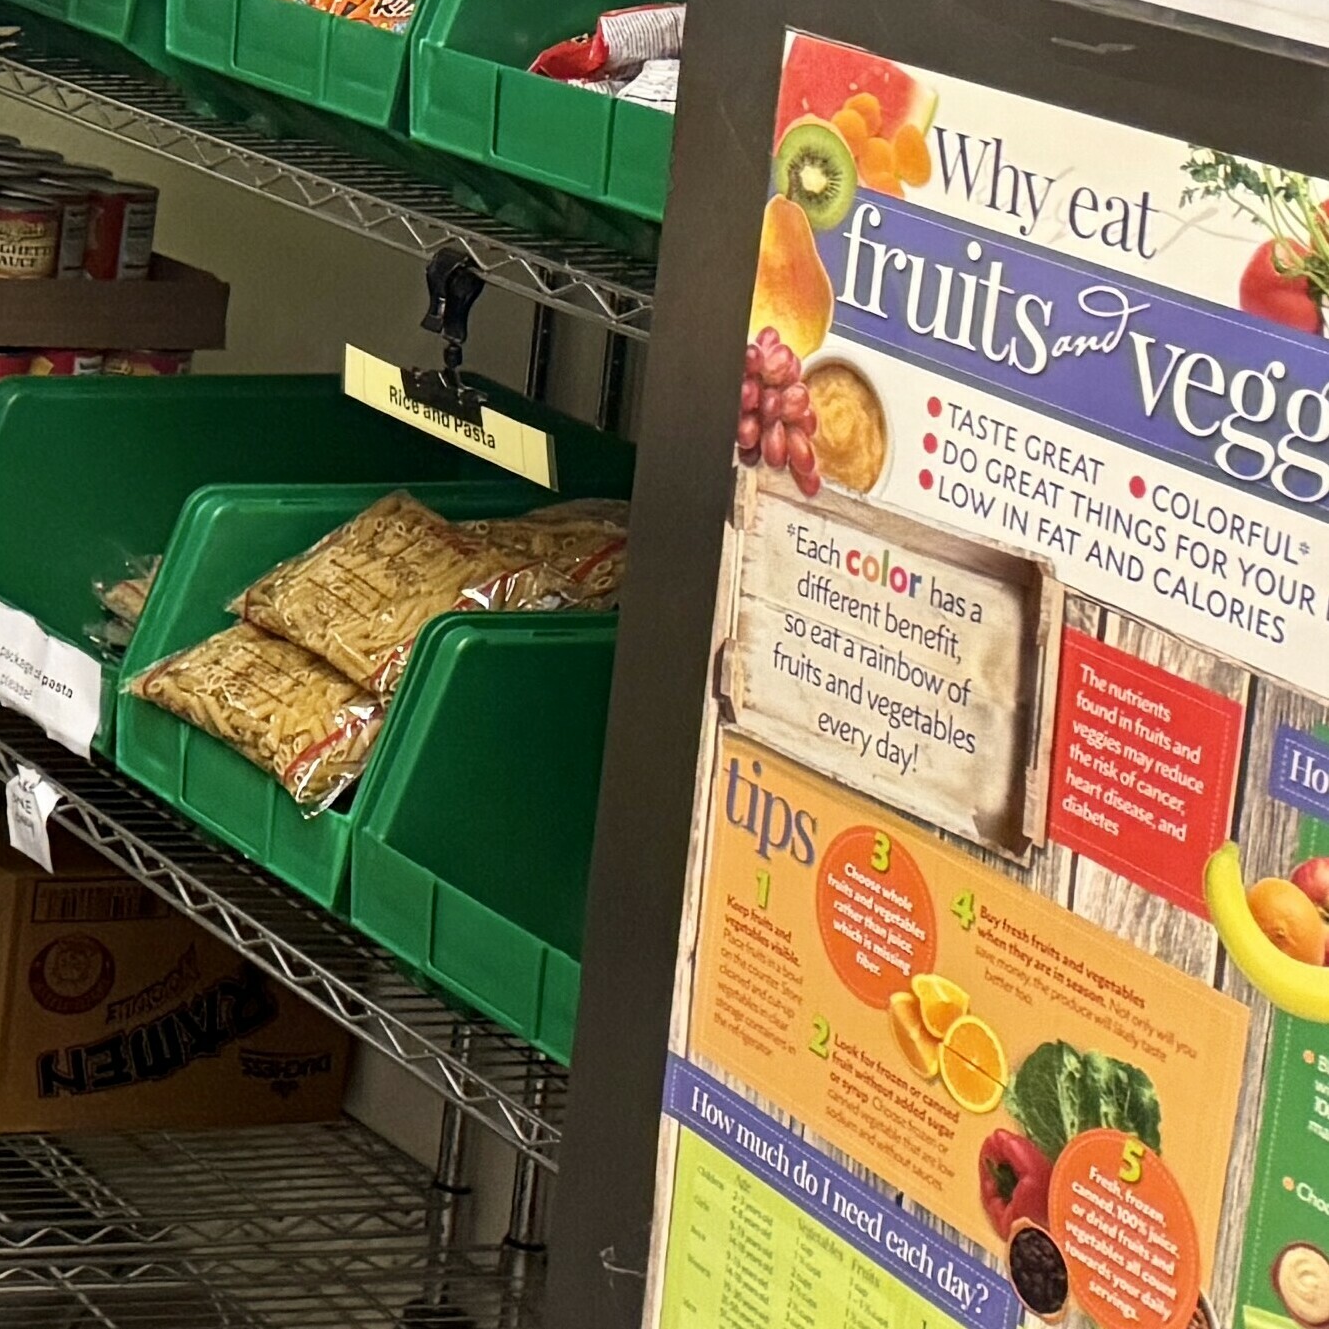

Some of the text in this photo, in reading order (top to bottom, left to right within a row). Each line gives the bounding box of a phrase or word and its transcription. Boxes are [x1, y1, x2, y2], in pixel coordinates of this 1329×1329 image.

[933, 126, 1158, 261] Why eat
[837, 203, 1054, 377] fruits
[1051, 285, 1151, 357] and
[388, 384, 420, 415] Rice
[454, 415, 497, 450] Pasta
[947, 401, 1105, 485] TASTE GREAT
[938, 475, 1285, 644] LOW IN FAT AND CALORIES
[942, 438, 1316, 616] DO GREAT THINGS FOR YOUR
[797, 570, 962, 666] different benefit,
[845, 549, 923, 599] color
[929, 576, 965, 618] has
[970, 602, 983, 624] a
[41, 674, 74, 700] pasta
[784, 613, 972, 707] so eat a rainbow of
[1079, 662, 1172, 723] The nutrients
[772, 641, 977, 755] fruits and vegetables
[1075, 689, 1202, 765] found in fruits and
[817, 711, 919, 776] every day!
[1069, 743, 1186, 817] the risk of cancer,
[1072, 719, 1205, 795] veggies may reduce
[721, 755, 819, 870] tips
[1061, 793, 1121, 837] diabetes
[1065, 766, 1188, 843] heart disease, and
[844, 862, 914, 913] Choose whole
[870, 831, 892, 873] 3
[755, 869, 771, 910] 1
[827, 872, 927, 942] fruits and vegetables
[951, 888, 976, 932] 4
[833, 899, 915, 957] rather than juice,
[809, 1015, 831, 1061] 2
[1118, 1139, 1146, 1184] 5
[691, 1086, 991, 1315] How much do I need each day?
